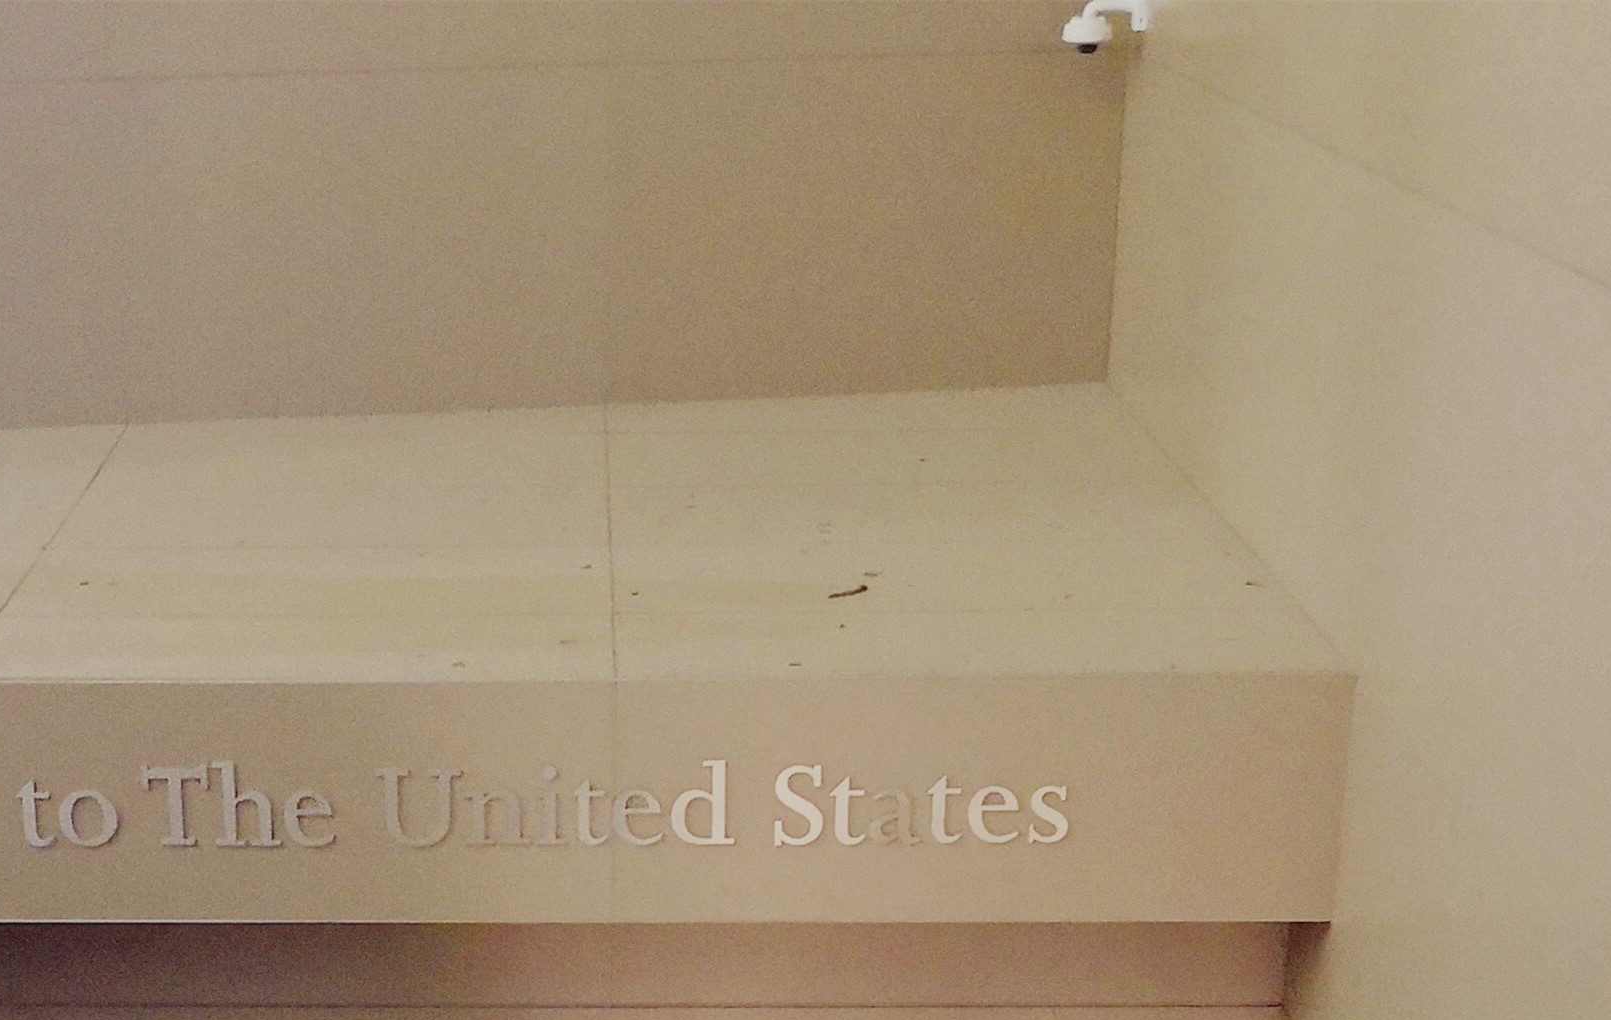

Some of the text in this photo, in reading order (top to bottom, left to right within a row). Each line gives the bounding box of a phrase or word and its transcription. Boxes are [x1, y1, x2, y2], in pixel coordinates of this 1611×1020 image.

[16, 780, 120, 849] to
[140, 760, 337, 849] The
[376, 759, 736, 849] United
[774, 764, 1069, 847] States
